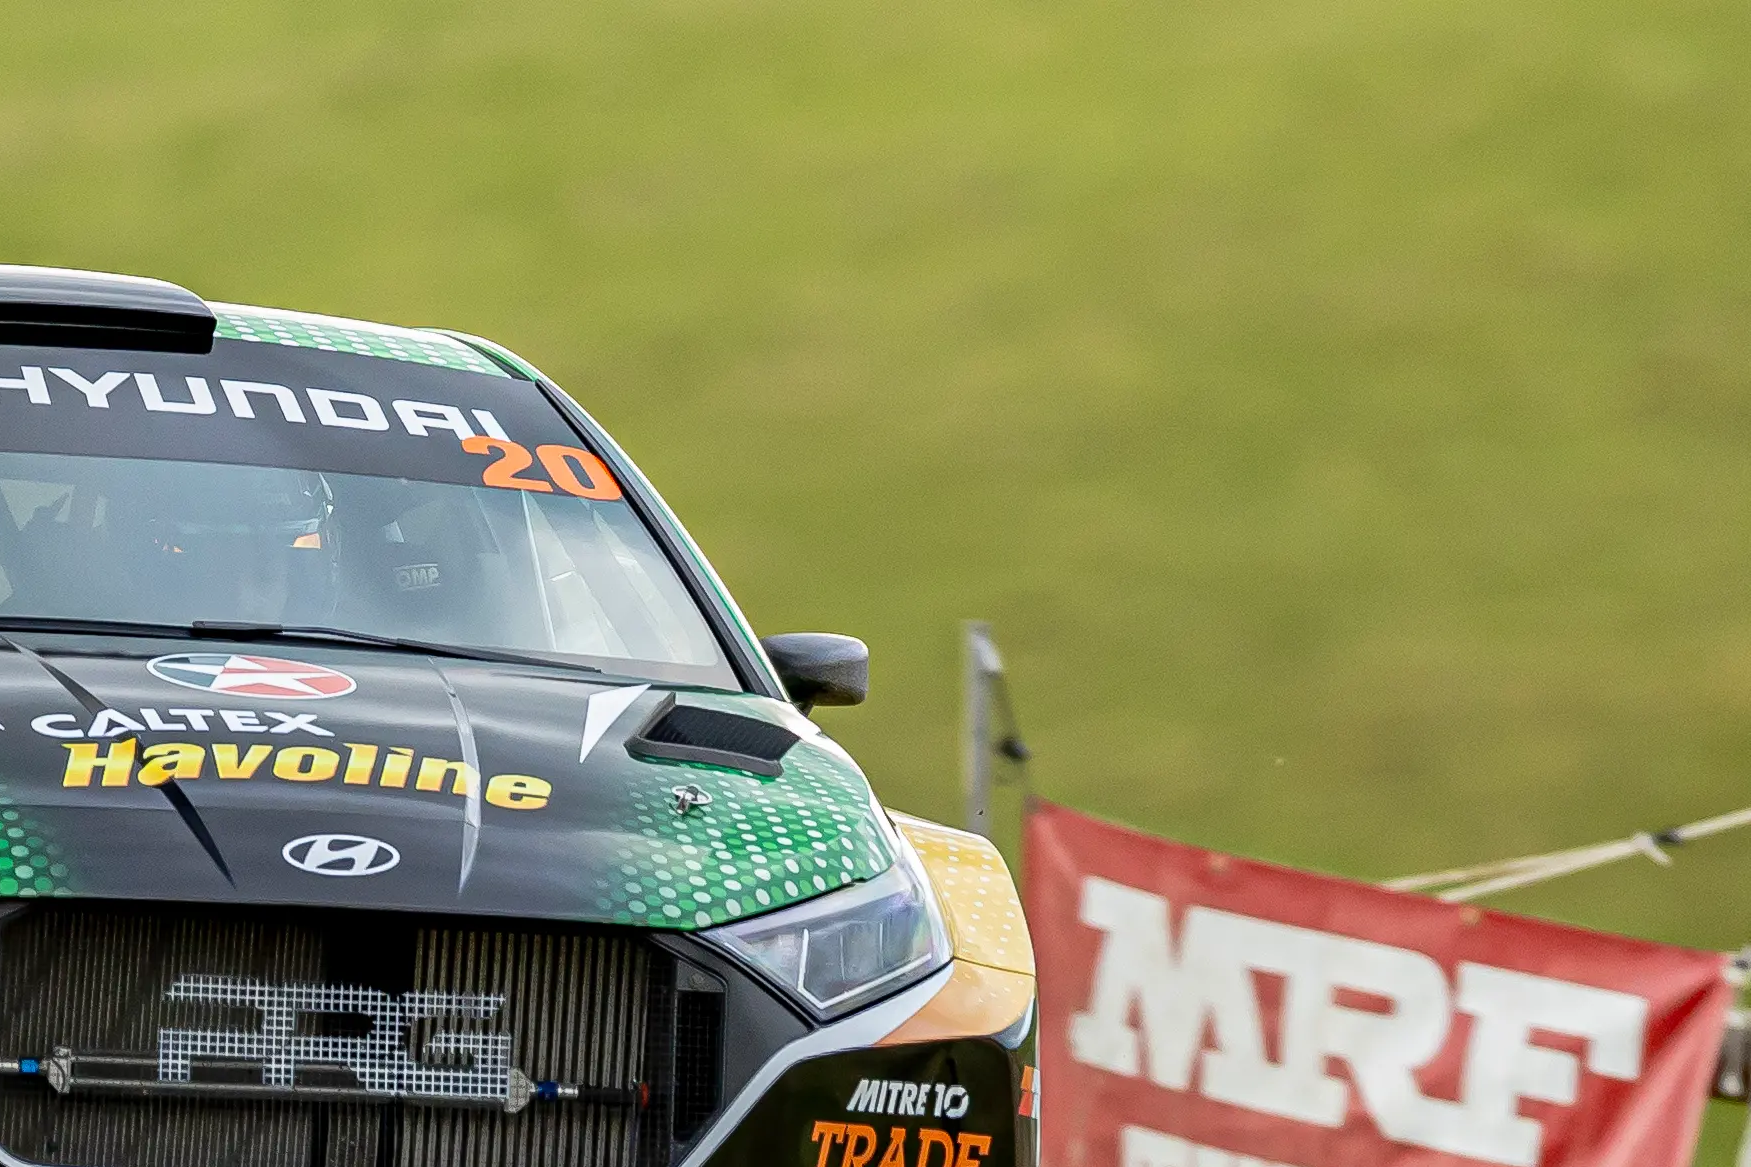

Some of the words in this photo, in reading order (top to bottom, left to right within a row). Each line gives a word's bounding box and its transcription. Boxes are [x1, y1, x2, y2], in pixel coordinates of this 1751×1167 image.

[462, 435, 623, 501] 20
[30, 707, 336, 740] CALTEX
[61, 736, 553, 811] Havoline
[846, 1078, 930, 1116] MITRE
[933, 1084, 971, 1119] 10
